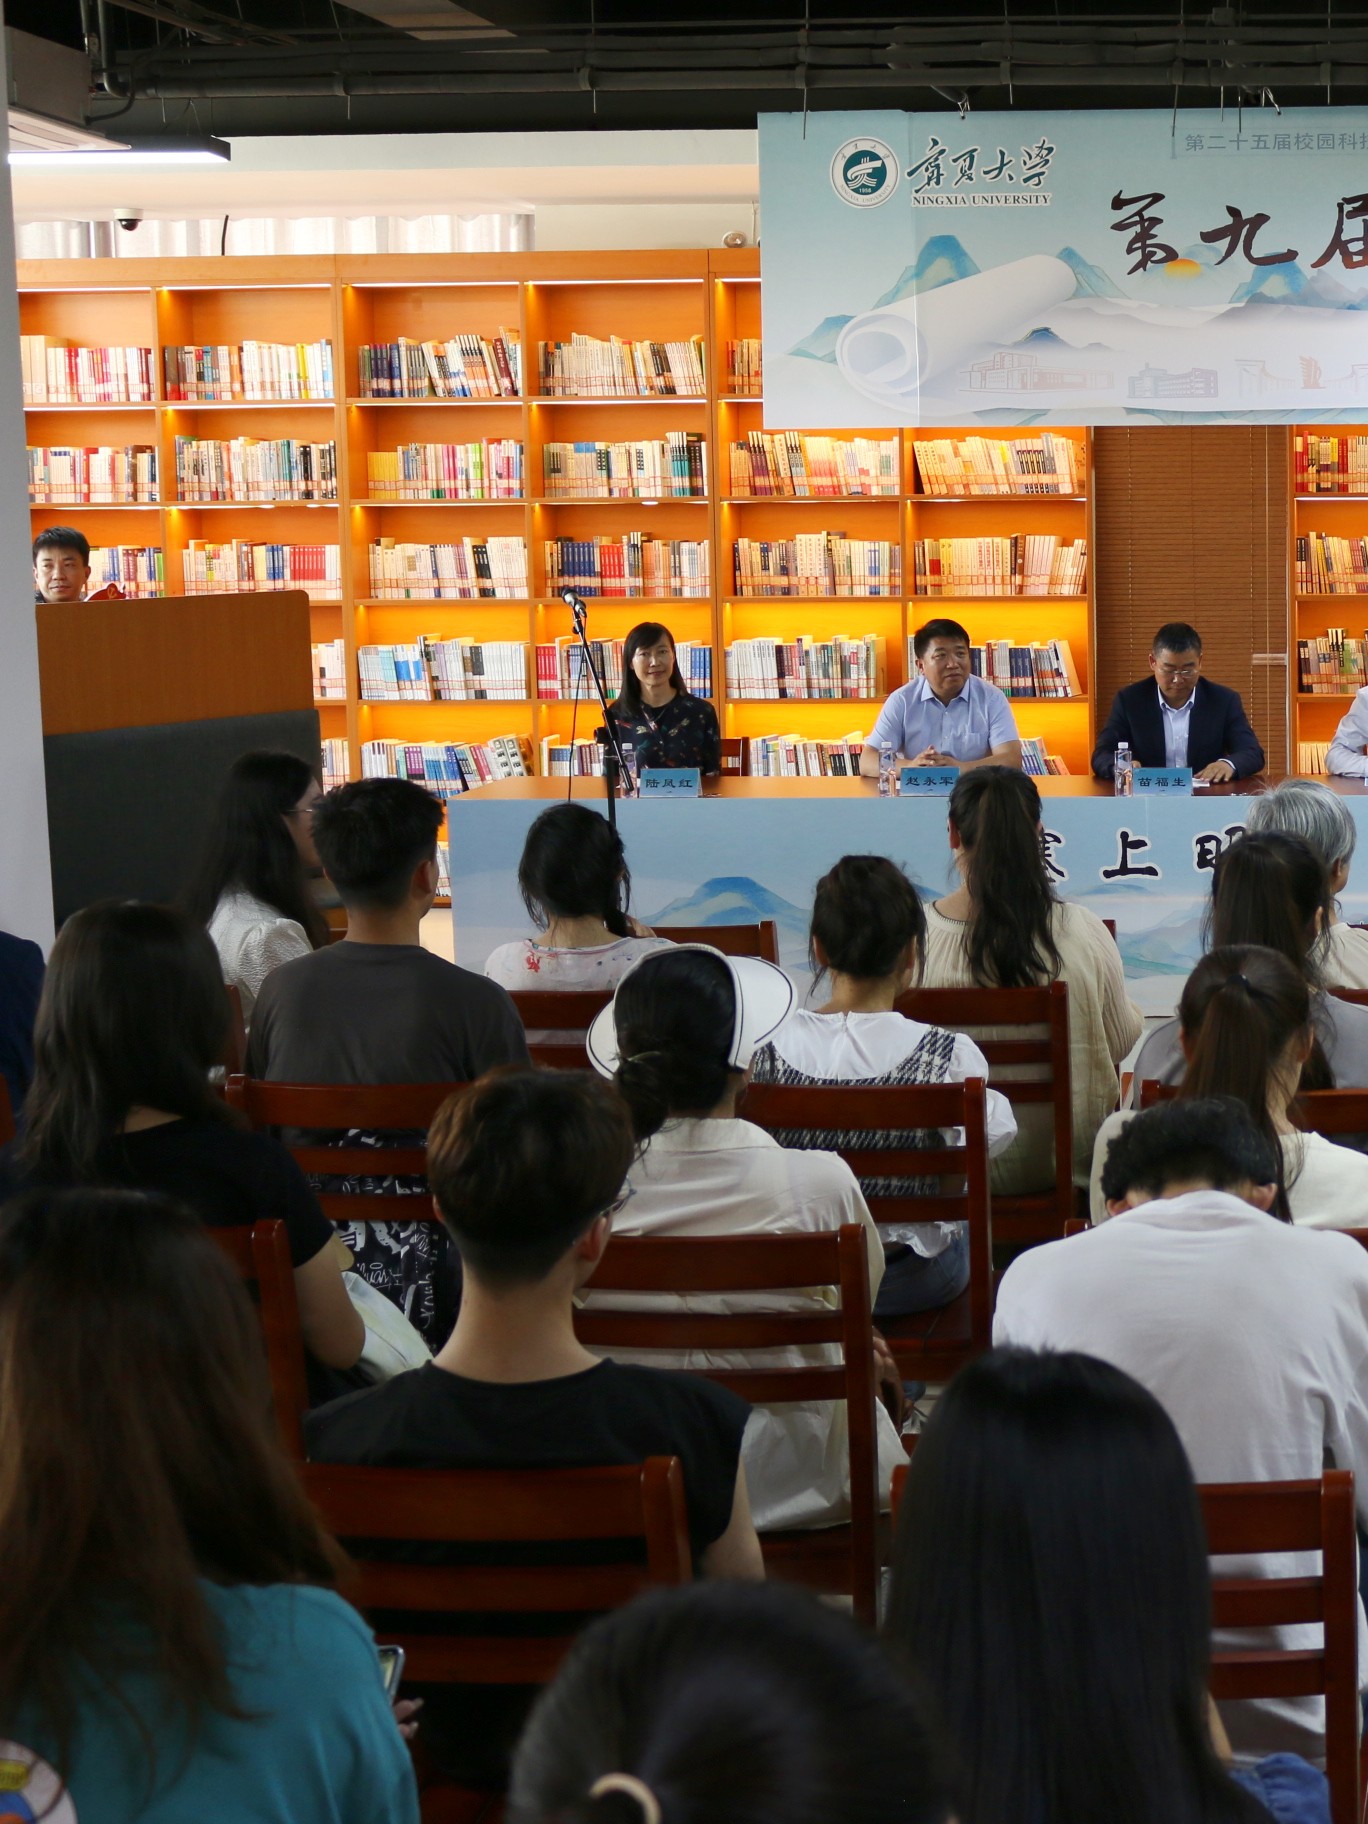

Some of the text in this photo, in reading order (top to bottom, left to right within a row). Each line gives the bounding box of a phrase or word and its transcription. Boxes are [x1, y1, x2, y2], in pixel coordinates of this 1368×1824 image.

[913, 194, 1050, 206] NINGXIA UNIVERSITY
[905, 776, 954, 786] 赵永军
[1138, 777, 1186, 787] 苗福生
